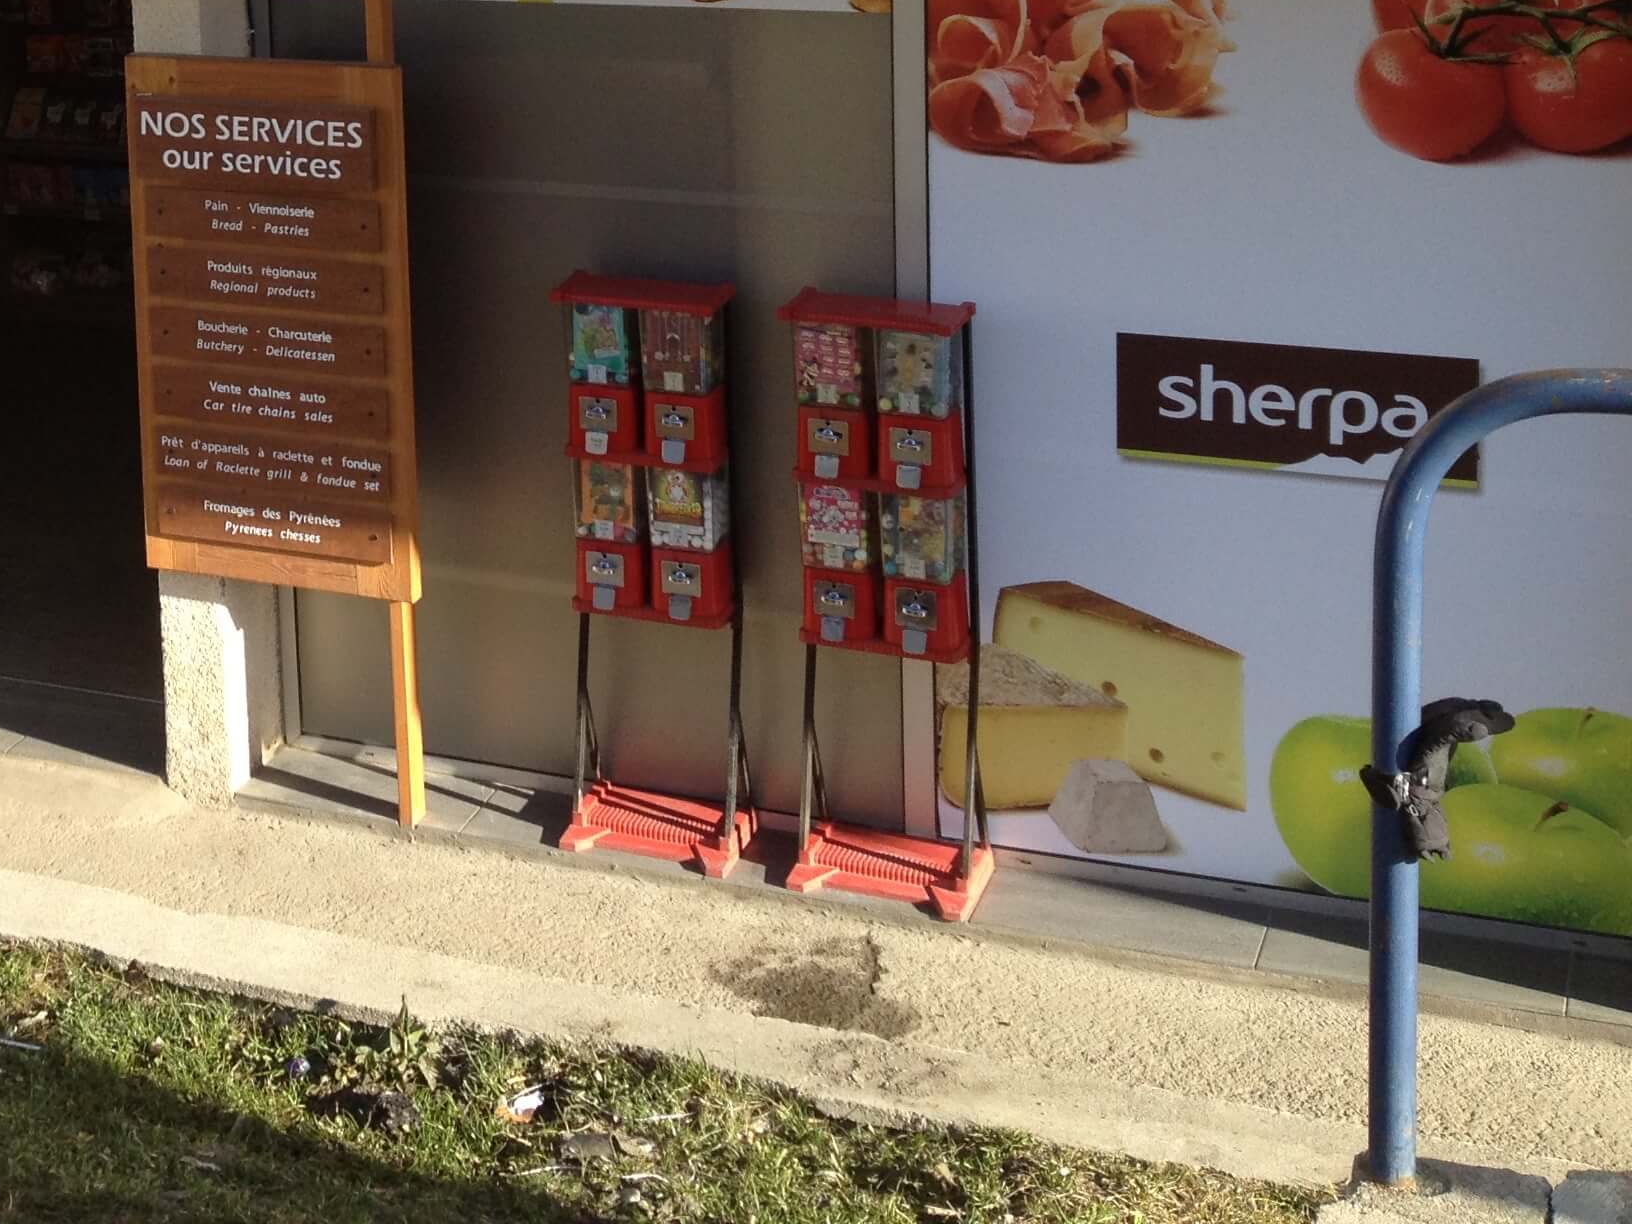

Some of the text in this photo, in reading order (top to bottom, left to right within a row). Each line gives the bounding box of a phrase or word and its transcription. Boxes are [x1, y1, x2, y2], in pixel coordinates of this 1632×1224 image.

[140, 110, 363, 149] NOS SERVICES
[162, 149, 342, 180] our services
[204, 199, 229, 212] Pain
[249, 202, 315, 219] Viennoiserie
[211, 218, 244, 232] Bread
[264, 222, 310, 237] Pastries
[207, 260, 253, 275] Produits
[210, 279, 316, 300] Regional products
[197, 319, 248, 335] Boucherie
[268, 326, 333, 344] Charcuterie
[196, 338, 244, 355] Butchery
[266, 345, 336, 362] Delicatessen
[209, 380, 241, 395] Vente
[299, 391, 326, 404] auto
[1157, 363, 1429, 445] sherpa
[203, 399, 334, 424] Car tire chains sales
[272, 449, 315, 465] raclette
[321, 456, 333, 467] et
[341, 456, 382, 473] fondue
[164, 455, 380, 492] Loan of Raclette grill & fondue set
[203, 499, 256, 518] Fromages
[262, 506, 281, 520] des
